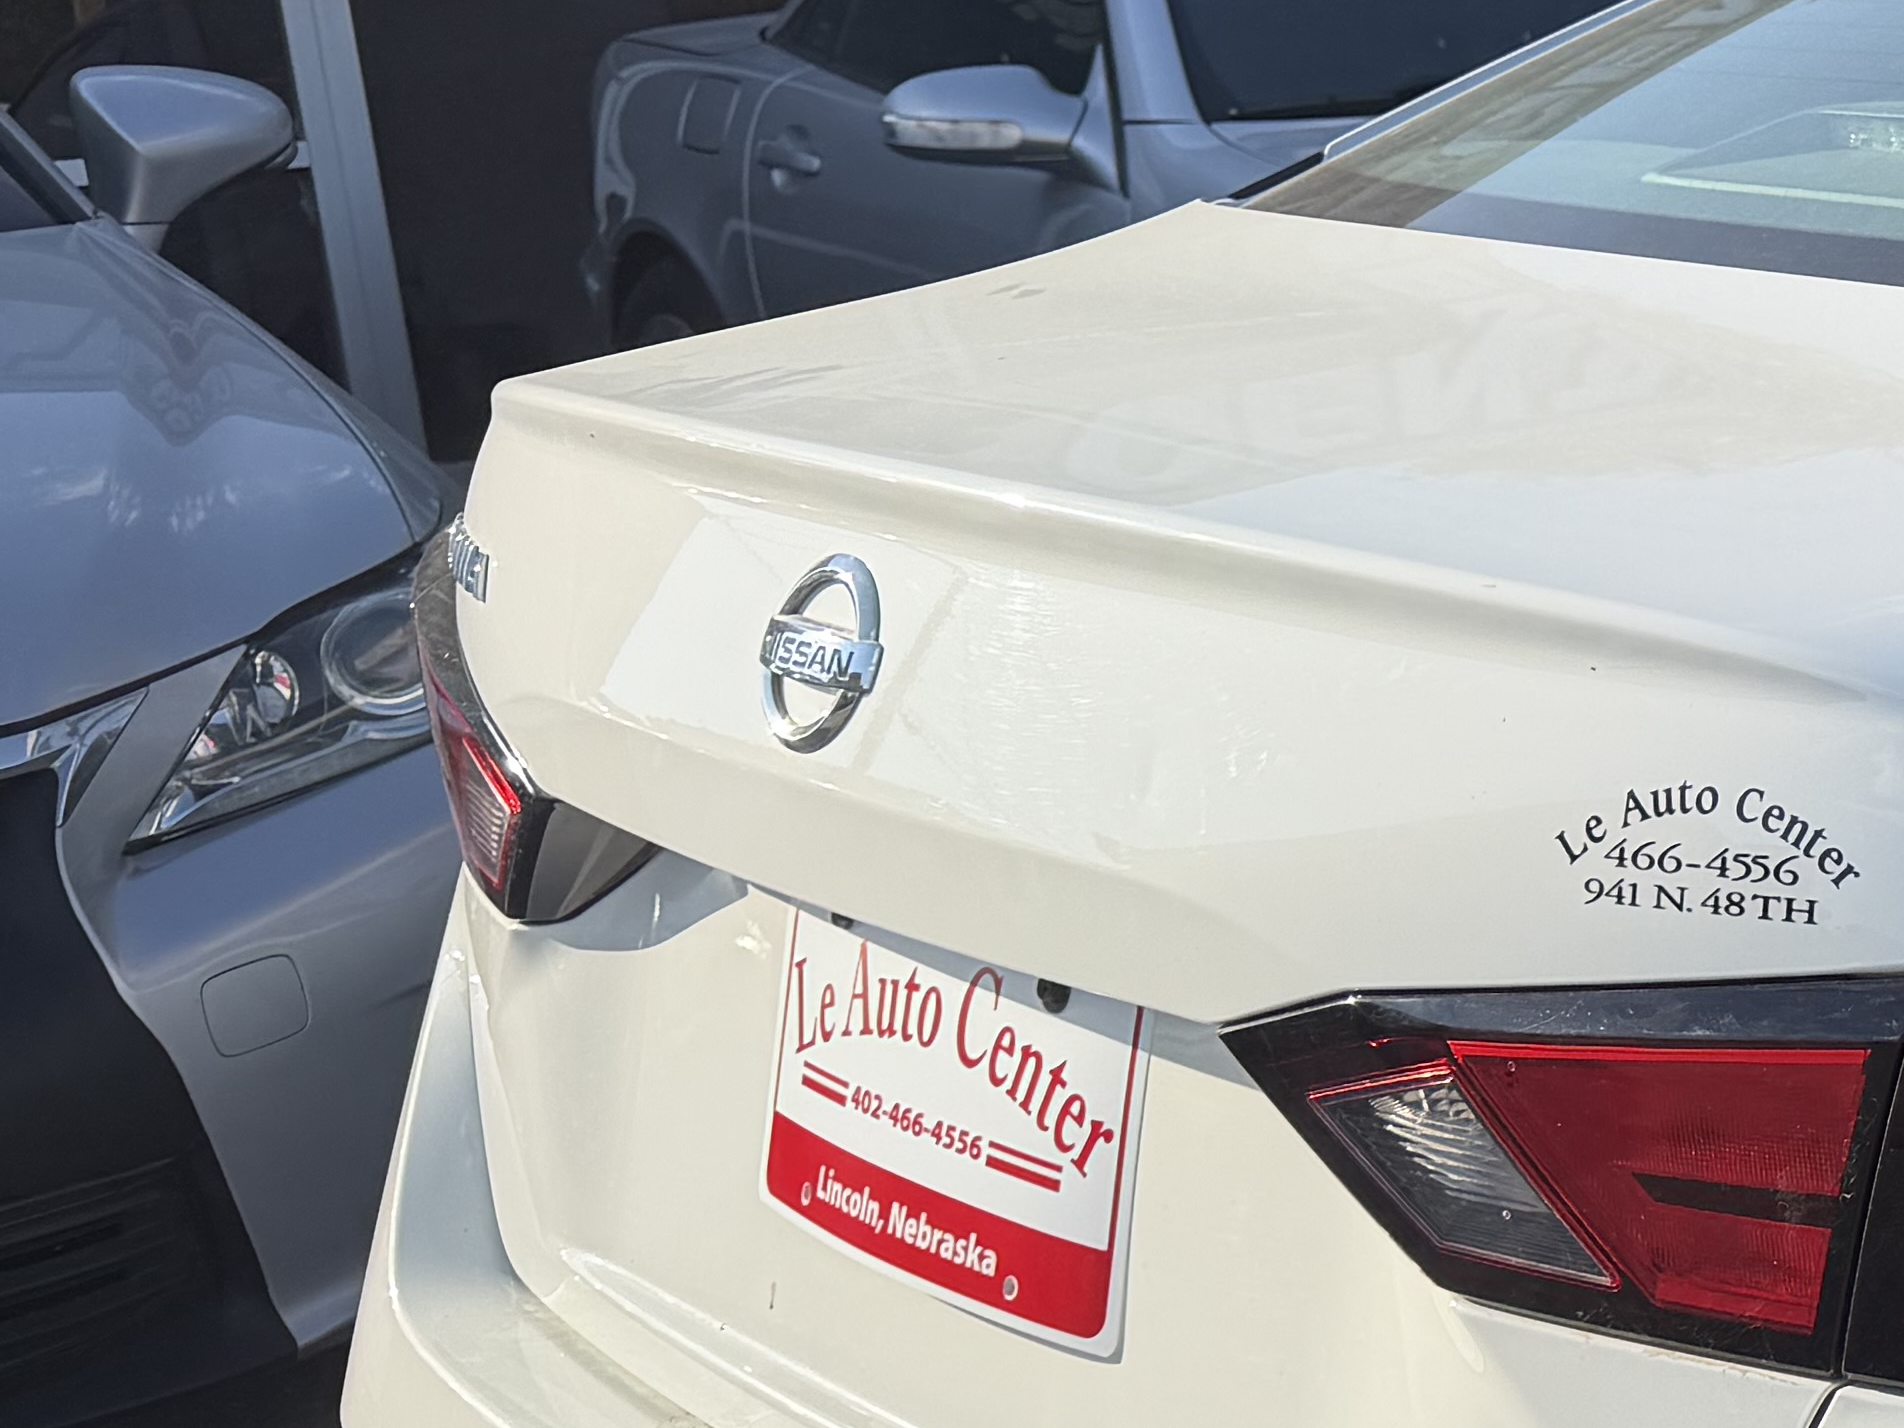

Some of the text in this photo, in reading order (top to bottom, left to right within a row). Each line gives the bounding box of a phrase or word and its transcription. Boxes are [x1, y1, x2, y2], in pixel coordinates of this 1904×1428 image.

[1555, 780, 1860, 890] Le Auto Center
[1604, 838, 1800, 886] 466-4556
[1584, 878, 1641, 908] 941
[1653, 884, 1693, 913] N.
[795, 939, 1115, 1178] Le Auto Center
[851, 1085, 983, 1161] 402-466-4556
[816, 1165, 998, 1277] Lincoln, Nebraska
